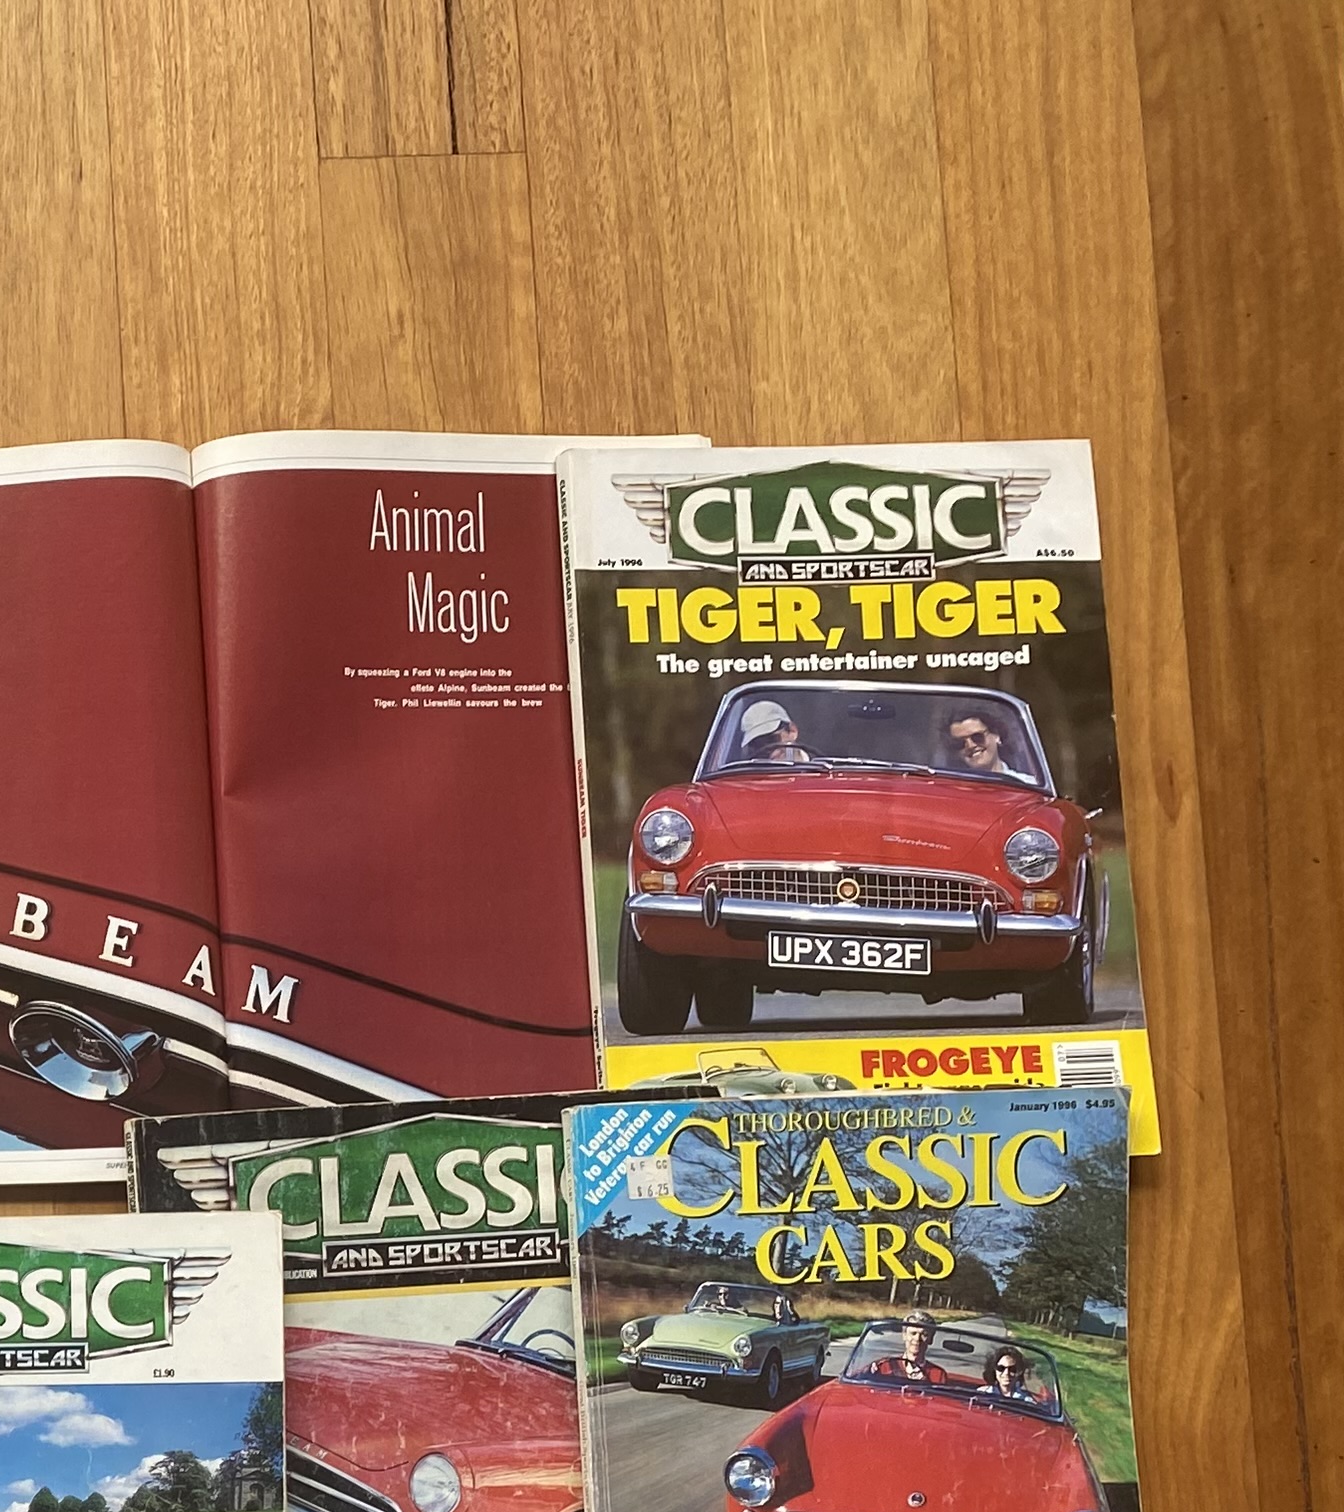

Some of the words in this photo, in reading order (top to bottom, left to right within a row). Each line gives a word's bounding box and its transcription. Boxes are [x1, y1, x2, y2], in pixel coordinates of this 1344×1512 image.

[370, 489, 485, 553] Animal
[678, 482, 993, 559] CLASSIC
[598, 558, 615, 567] July
[745, 561, 789, 580] AND
[793, 558, 929, 578] SPORTSCAR
[408, 572, 510, 644] Magic
[617, 586, 845, 649] TIGER,
[850, 580, 1066, 640] TIGER
[657, 654, 699, 673] The
[708, 654, 773, 678] great
[780, 650, 916, 672] entertainer
[926, 645, 1031, 671] uncaged
[772, 934, 833, 966] UPX
[840, 939, 926, 970] 362F
[861, 1046, 1043, 1078] FROGEYE
[735, 1109, 953, 1133] THOROUGHBRED
[956, 1106, 977, 1125] &
[655, 1118, 1068, 1217] CLASSIC
[757, 1220, 956, 1284] CARS
[153, 1369, 174, 1378] £1.90
